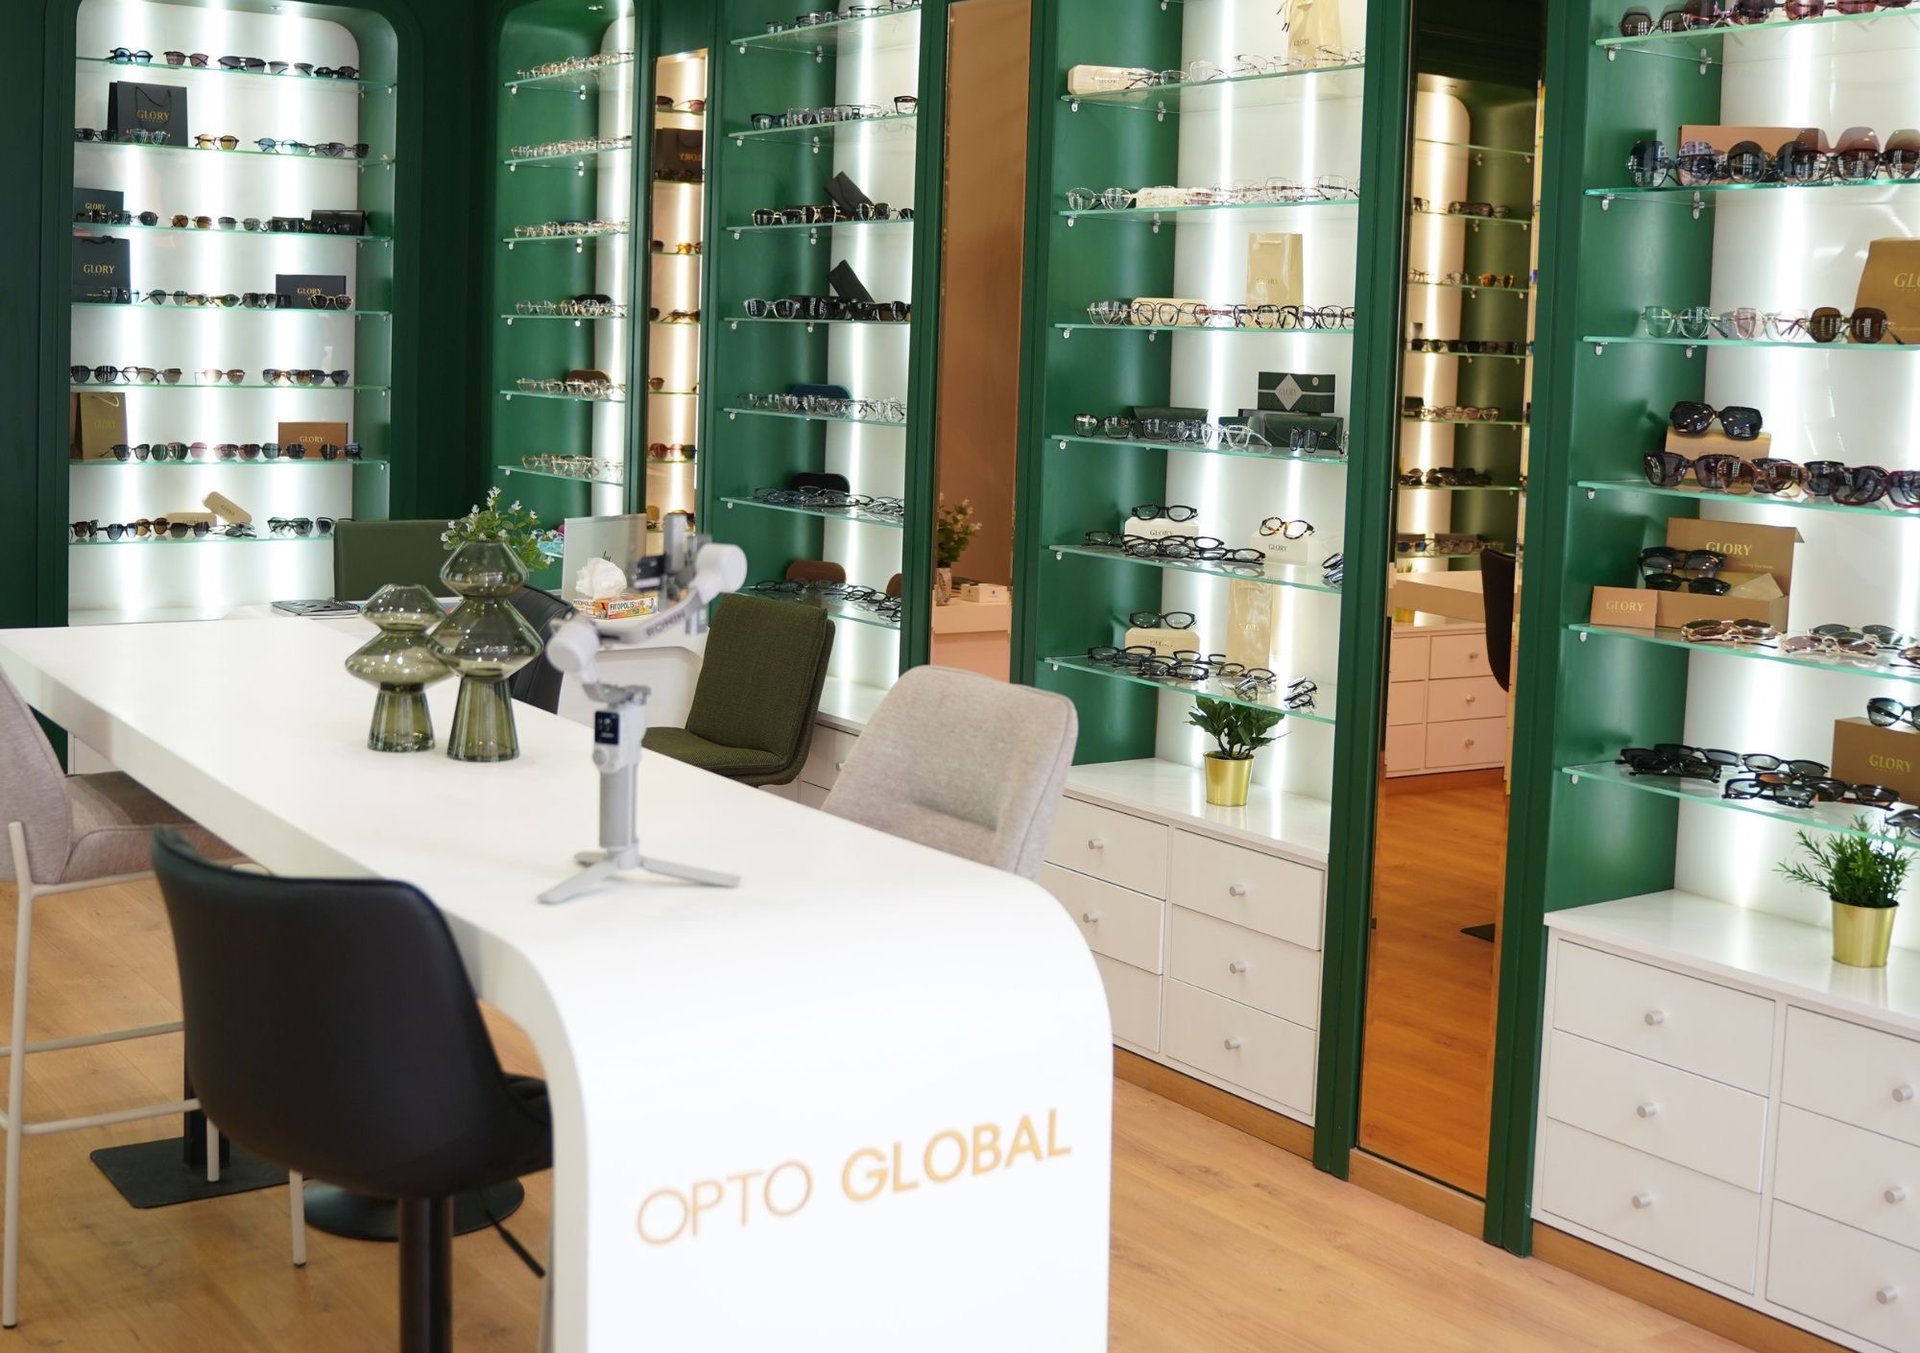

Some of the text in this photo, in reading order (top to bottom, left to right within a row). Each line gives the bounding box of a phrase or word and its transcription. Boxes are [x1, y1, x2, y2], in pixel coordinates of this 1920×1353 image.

[136, 110, 170, 120] GLORY
[85, 202, 106, 211] GLORY
[83, 264, 115, 274] GLORY
[1894, 272, 1920, 288] GL
[297, 287, 322, 295] GLORY
[299, 435, 323, 443] GLORY
[1705, 541, 1752, 556] GLORY
[1606, 600, 1644, 612] GLORY
[1869, 754, 1913, 773] GLORY
[636, 1107, 1073, 1246] OPTO GLOBAL
